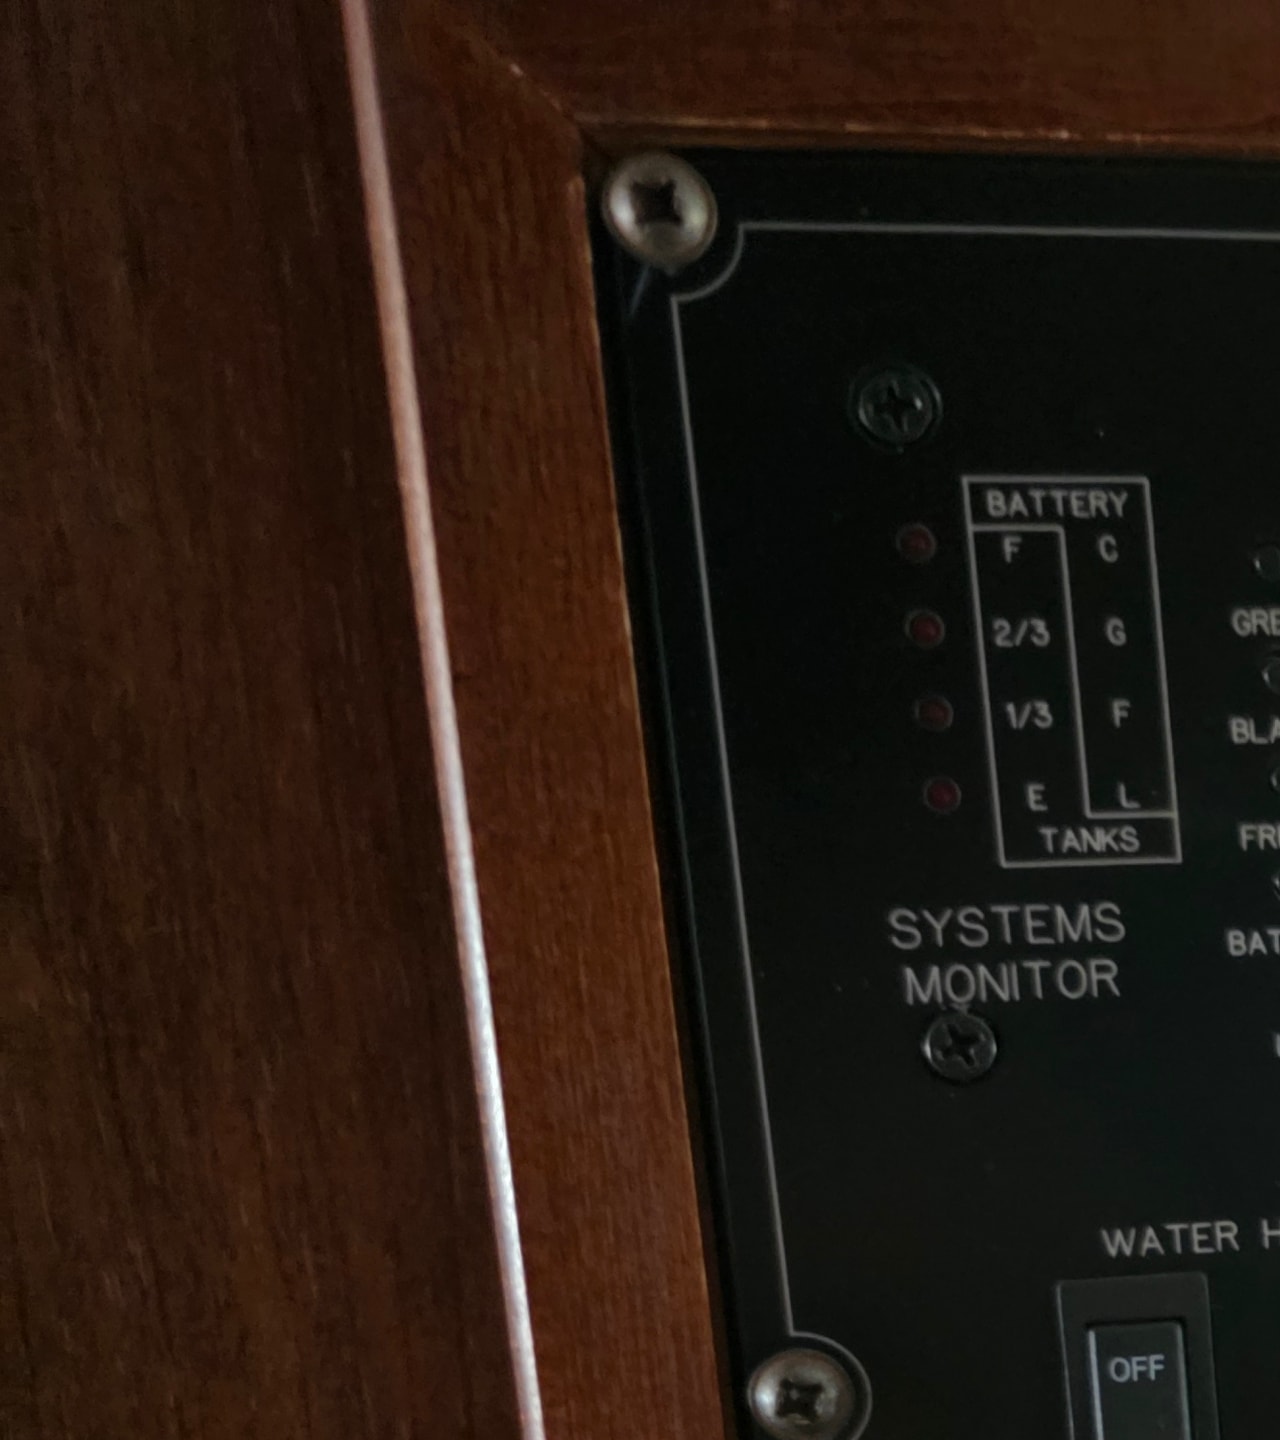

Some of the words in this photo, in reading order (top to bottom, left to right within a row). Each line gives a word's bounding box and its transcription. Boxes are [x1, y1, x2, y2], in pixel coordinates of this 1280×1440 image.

[986, 489, 1129, 519] BATTERY
[1002, 534, 1023, 564] F
[1098, 536, 1120, 563] C
[993, 617, 1051, 648] 2/3
[1106, 617, 1127, 647] G
[1005, 700, 1054, 730] 1/3
[1111, 698, 1131, 728] F
[1026, 783, 1048, 812] E
[1118, 782, 1140, 809] L
[1039, 827, 1140, 854] TANKS
[887, 902, 1126, 951] SYSTEMS
[903, 958, 1121, 1006] MONITOR
[1100, 1220, 1241, 1260] WATER
[1107, 1353, 1166, 1384] OFF
